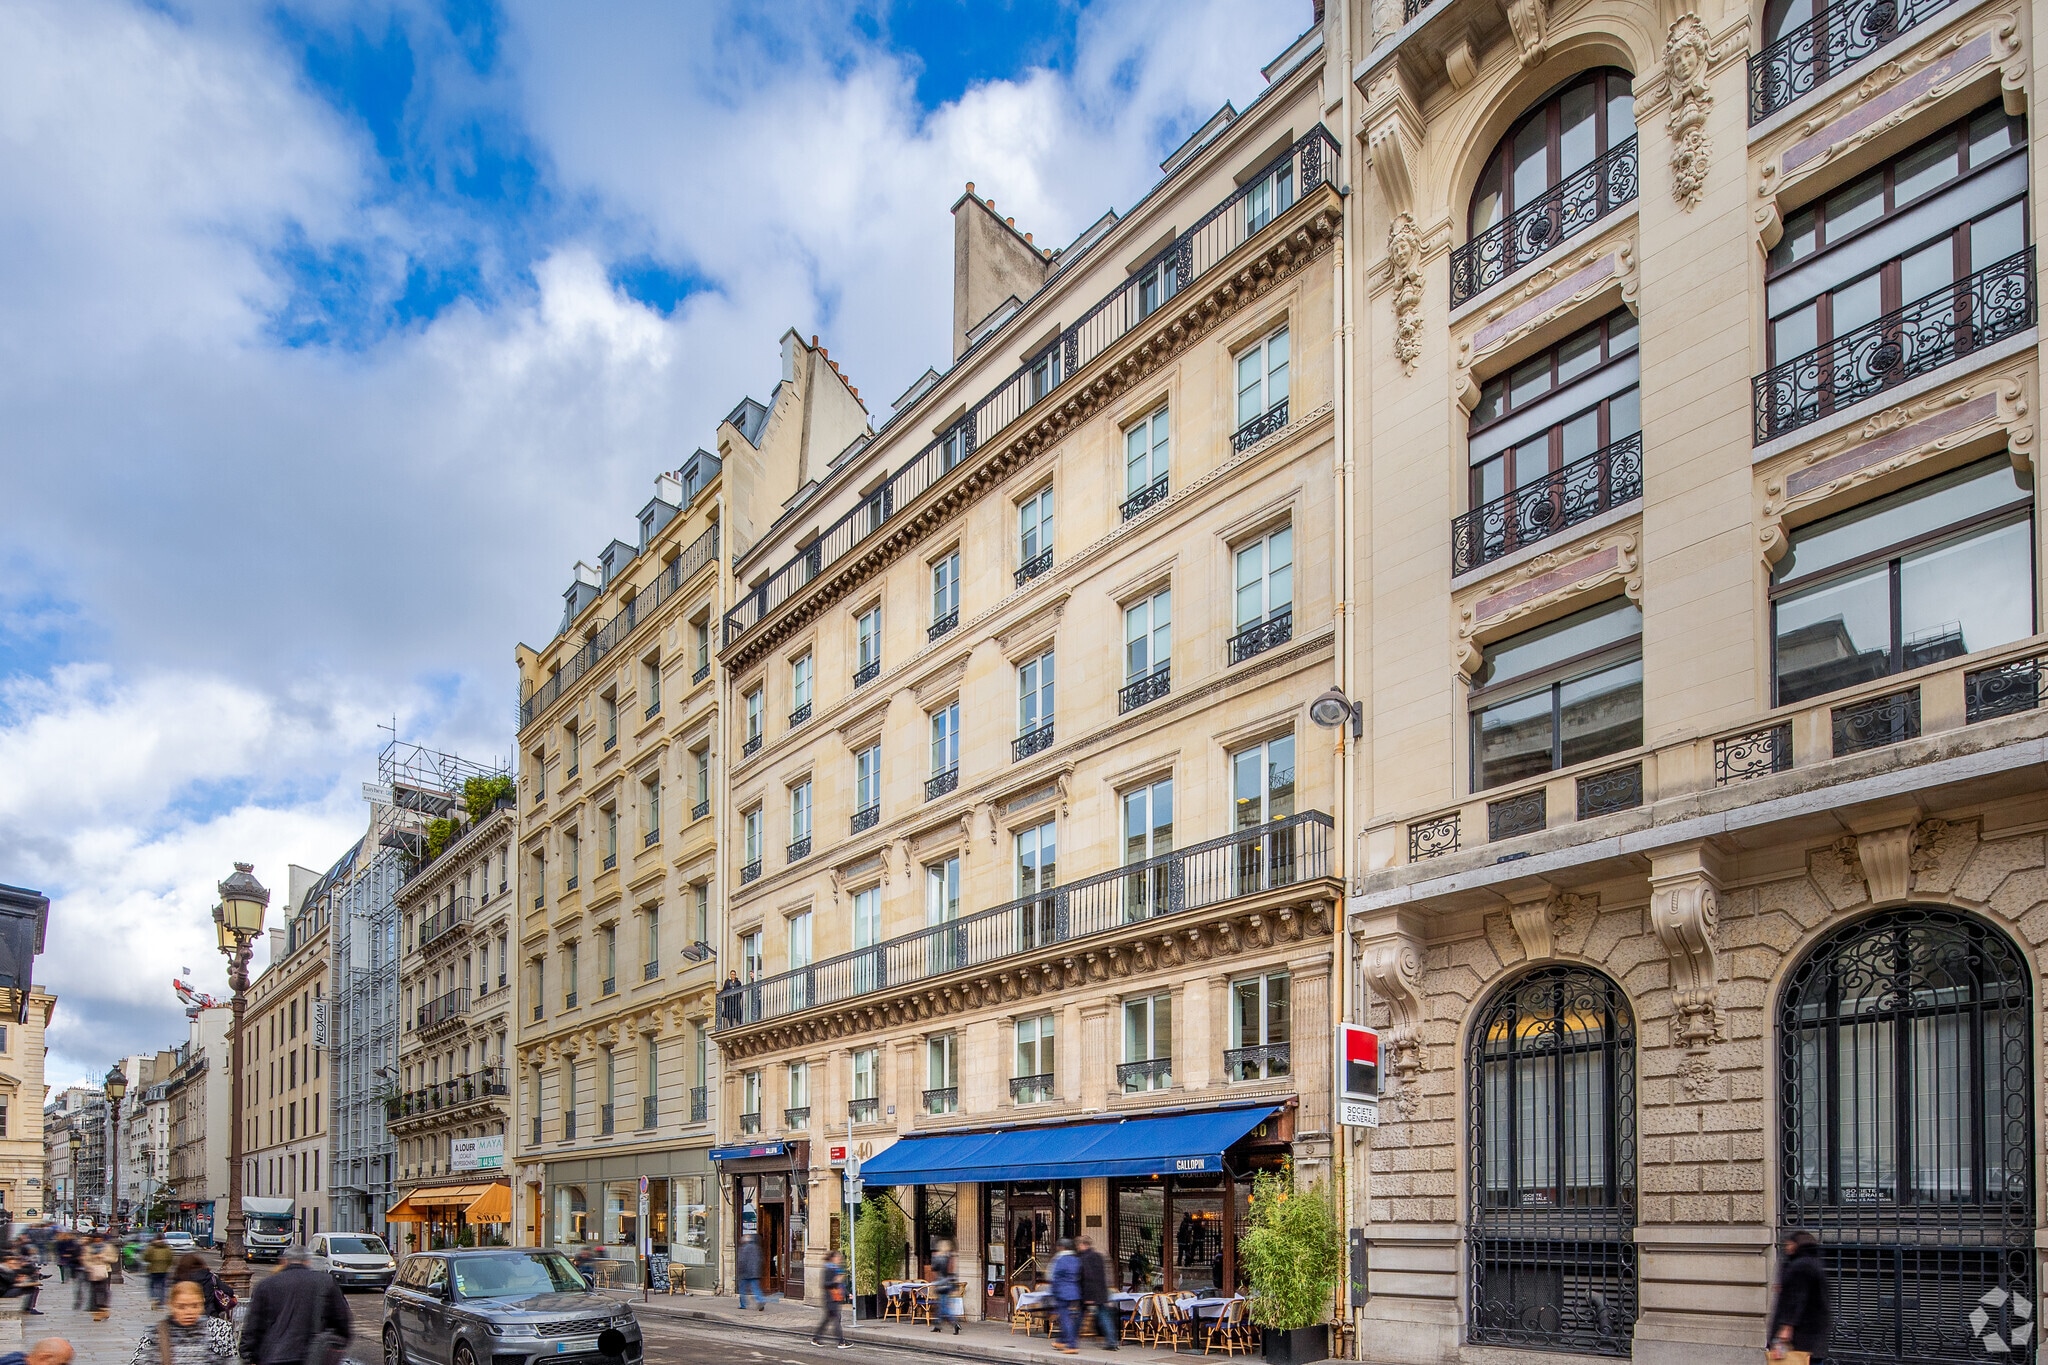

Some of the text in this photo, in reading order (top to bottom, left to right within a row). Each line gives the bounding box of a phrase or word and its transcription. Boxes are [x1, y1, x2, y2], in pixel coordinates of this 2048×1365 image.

[314, 1004, 326, 1044] NEOXAM
[460, 1143, 475, 1152] LOUER
[479, 1139, 502, 1149] MAYA
[857, 1141, 872, 1160] 40
[1176, 1159, 1205, 1170] GALLOPIN
